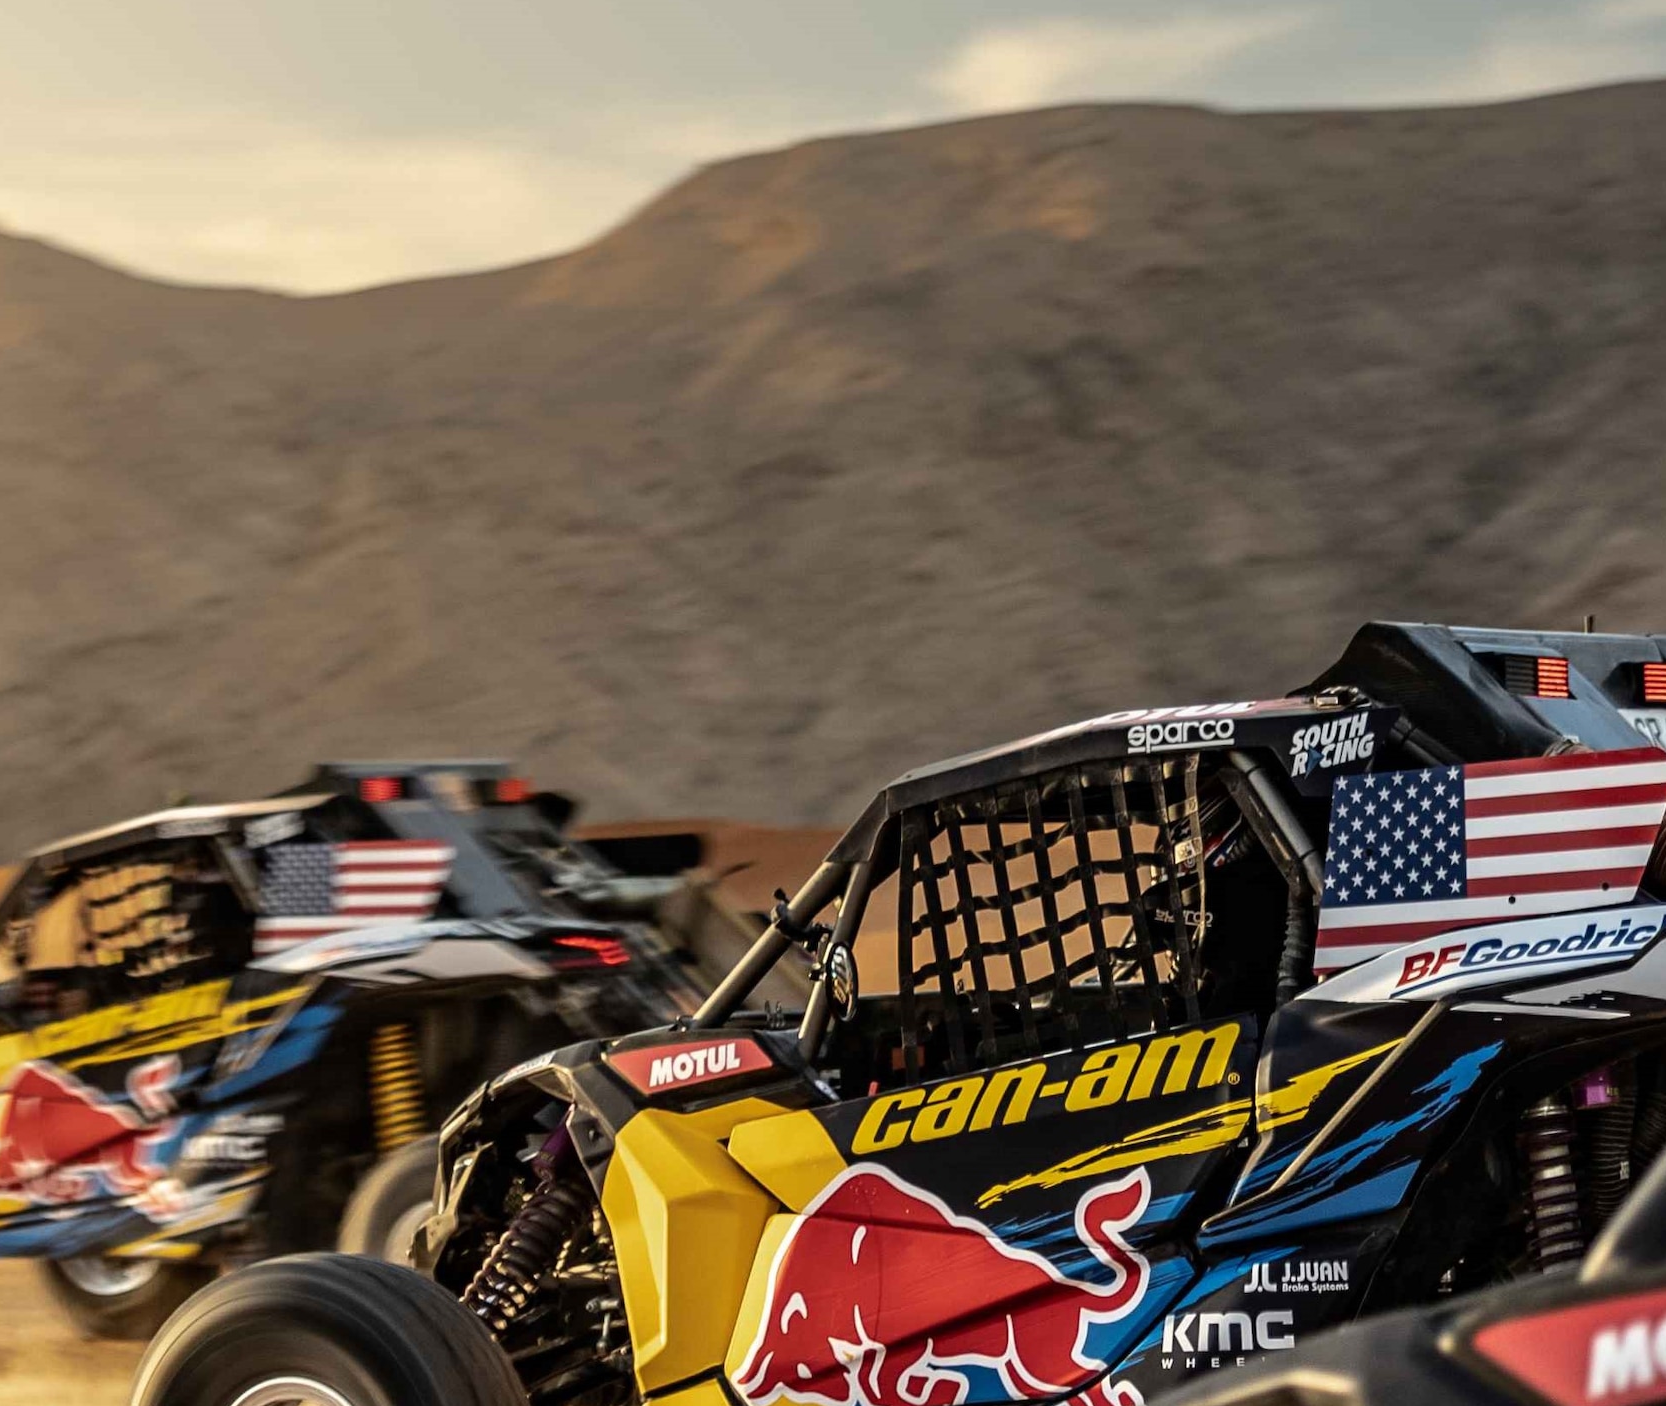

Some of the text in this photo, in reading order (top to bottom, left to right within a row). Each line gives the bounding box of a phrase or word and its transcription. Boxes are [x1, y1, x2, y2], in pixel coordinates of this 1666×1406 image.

[1127, 718, 1235, 754] sparco
[1290, 710, 1370, 755] SOUTH
[649, 1042, 741, 1088] MOTUL
[850, 1022, 1241, 1155] can-am
[1282, 1282, 1350, 1295] Brake Systems
